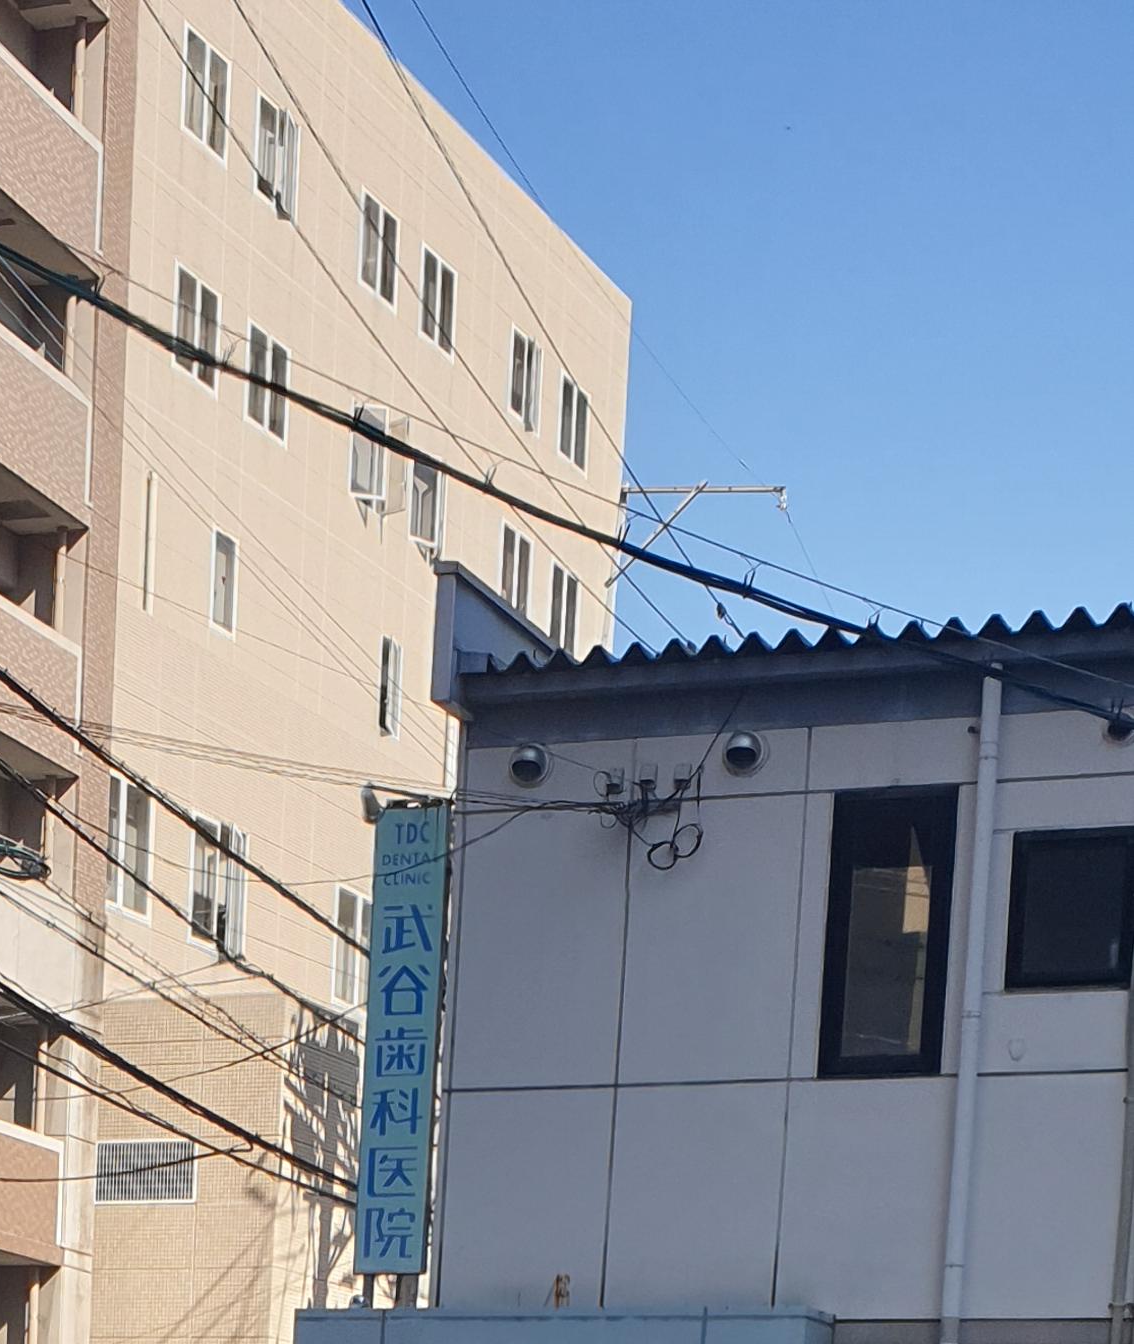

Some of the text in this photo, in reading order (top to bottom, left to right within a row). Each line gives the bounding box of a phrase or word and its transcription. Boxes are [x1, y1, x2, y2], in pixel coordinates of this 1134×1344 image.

[394, 820, 430, 845] TDC
[383, 871, 431, 886] CLINIC
[364, 904, 435, 1259] 武谷歯科医院
